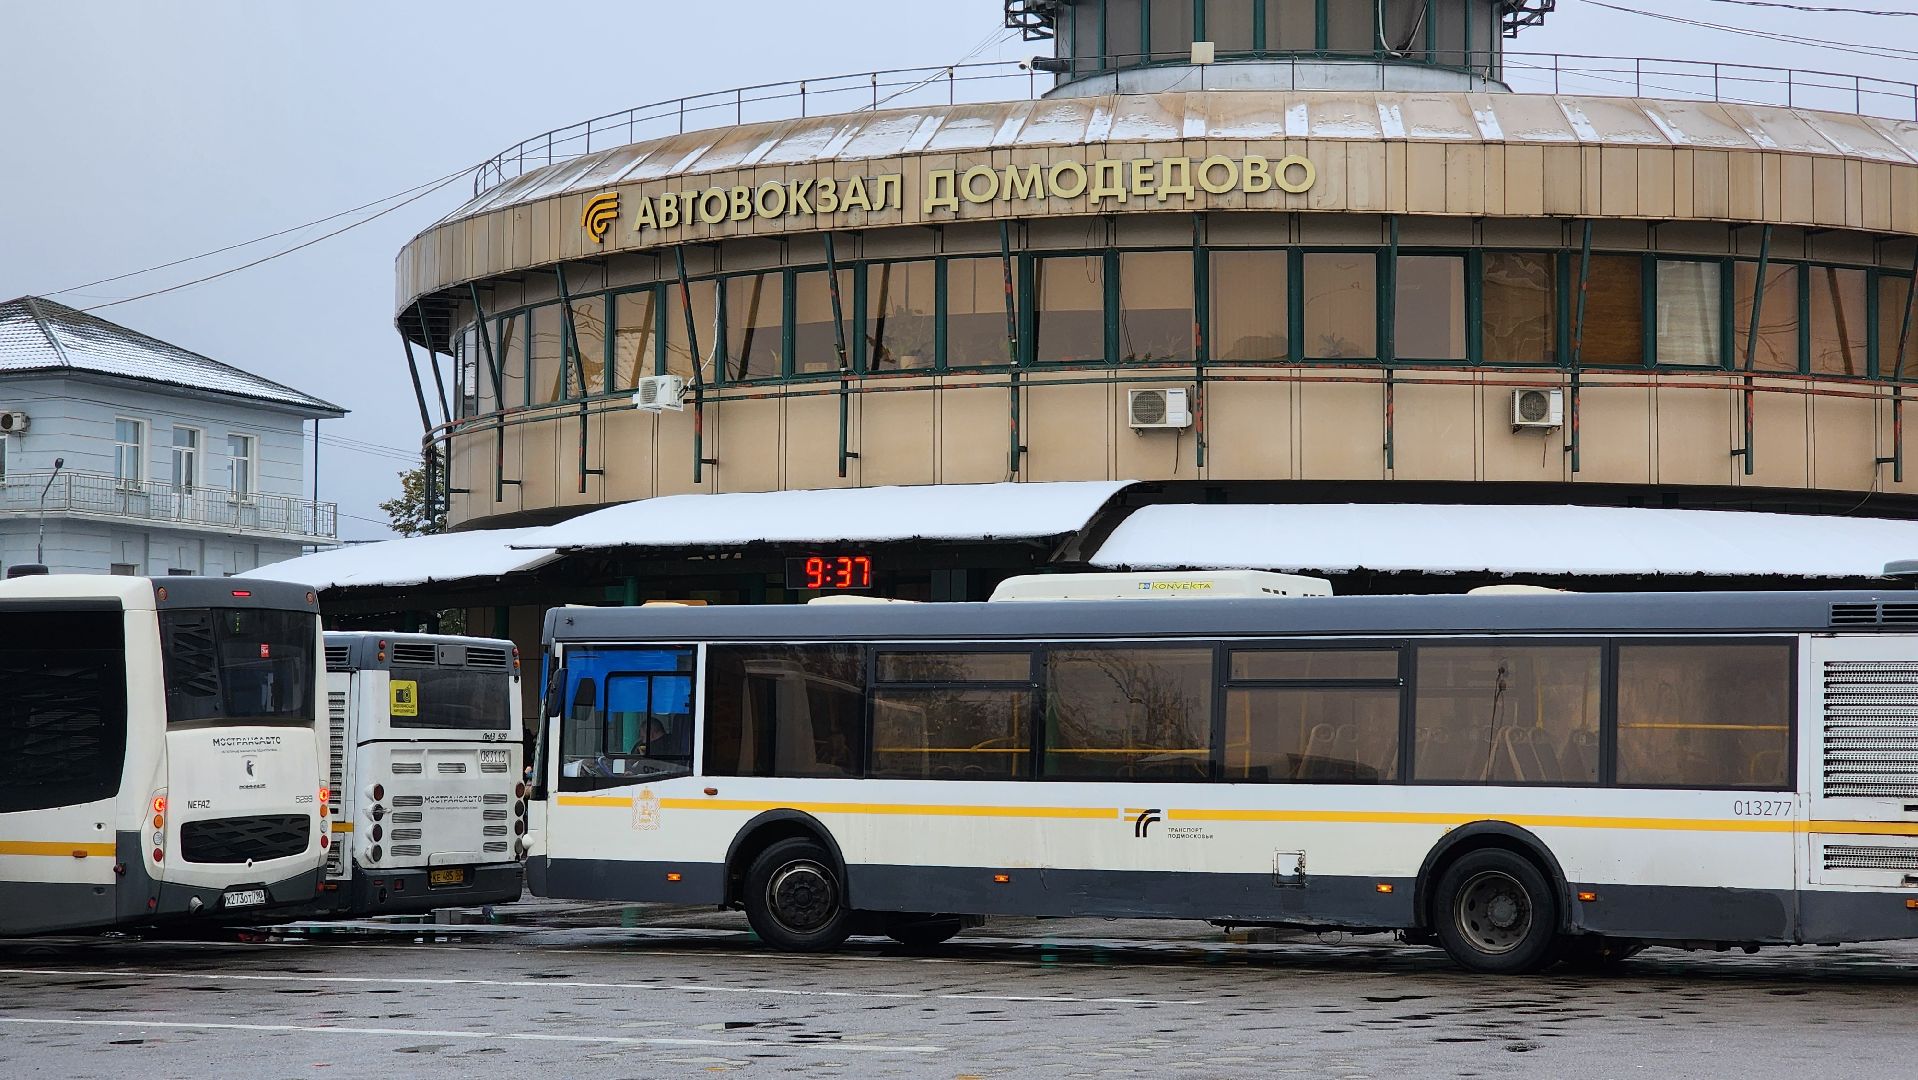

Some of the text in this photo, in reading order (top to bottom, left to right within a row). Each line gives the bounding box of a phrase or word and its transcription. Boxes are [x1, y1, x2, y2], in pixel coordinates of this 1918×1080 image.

[633, 154, 1317, 231] АВТОВОКЗАЛ ДОМОДЕДОВО
[805, 556, 871, 589] 9:37
[1151, 581, 1211, 591] KONVEKTA
[212, 736, 281, 747] МОСТРАНСАВТО
[187, 799, 211, 809] NEFAZ
[424, 795, 482, 804] МОСТРАНСАВТО
[1733, 800, 1792, 816] 013277
